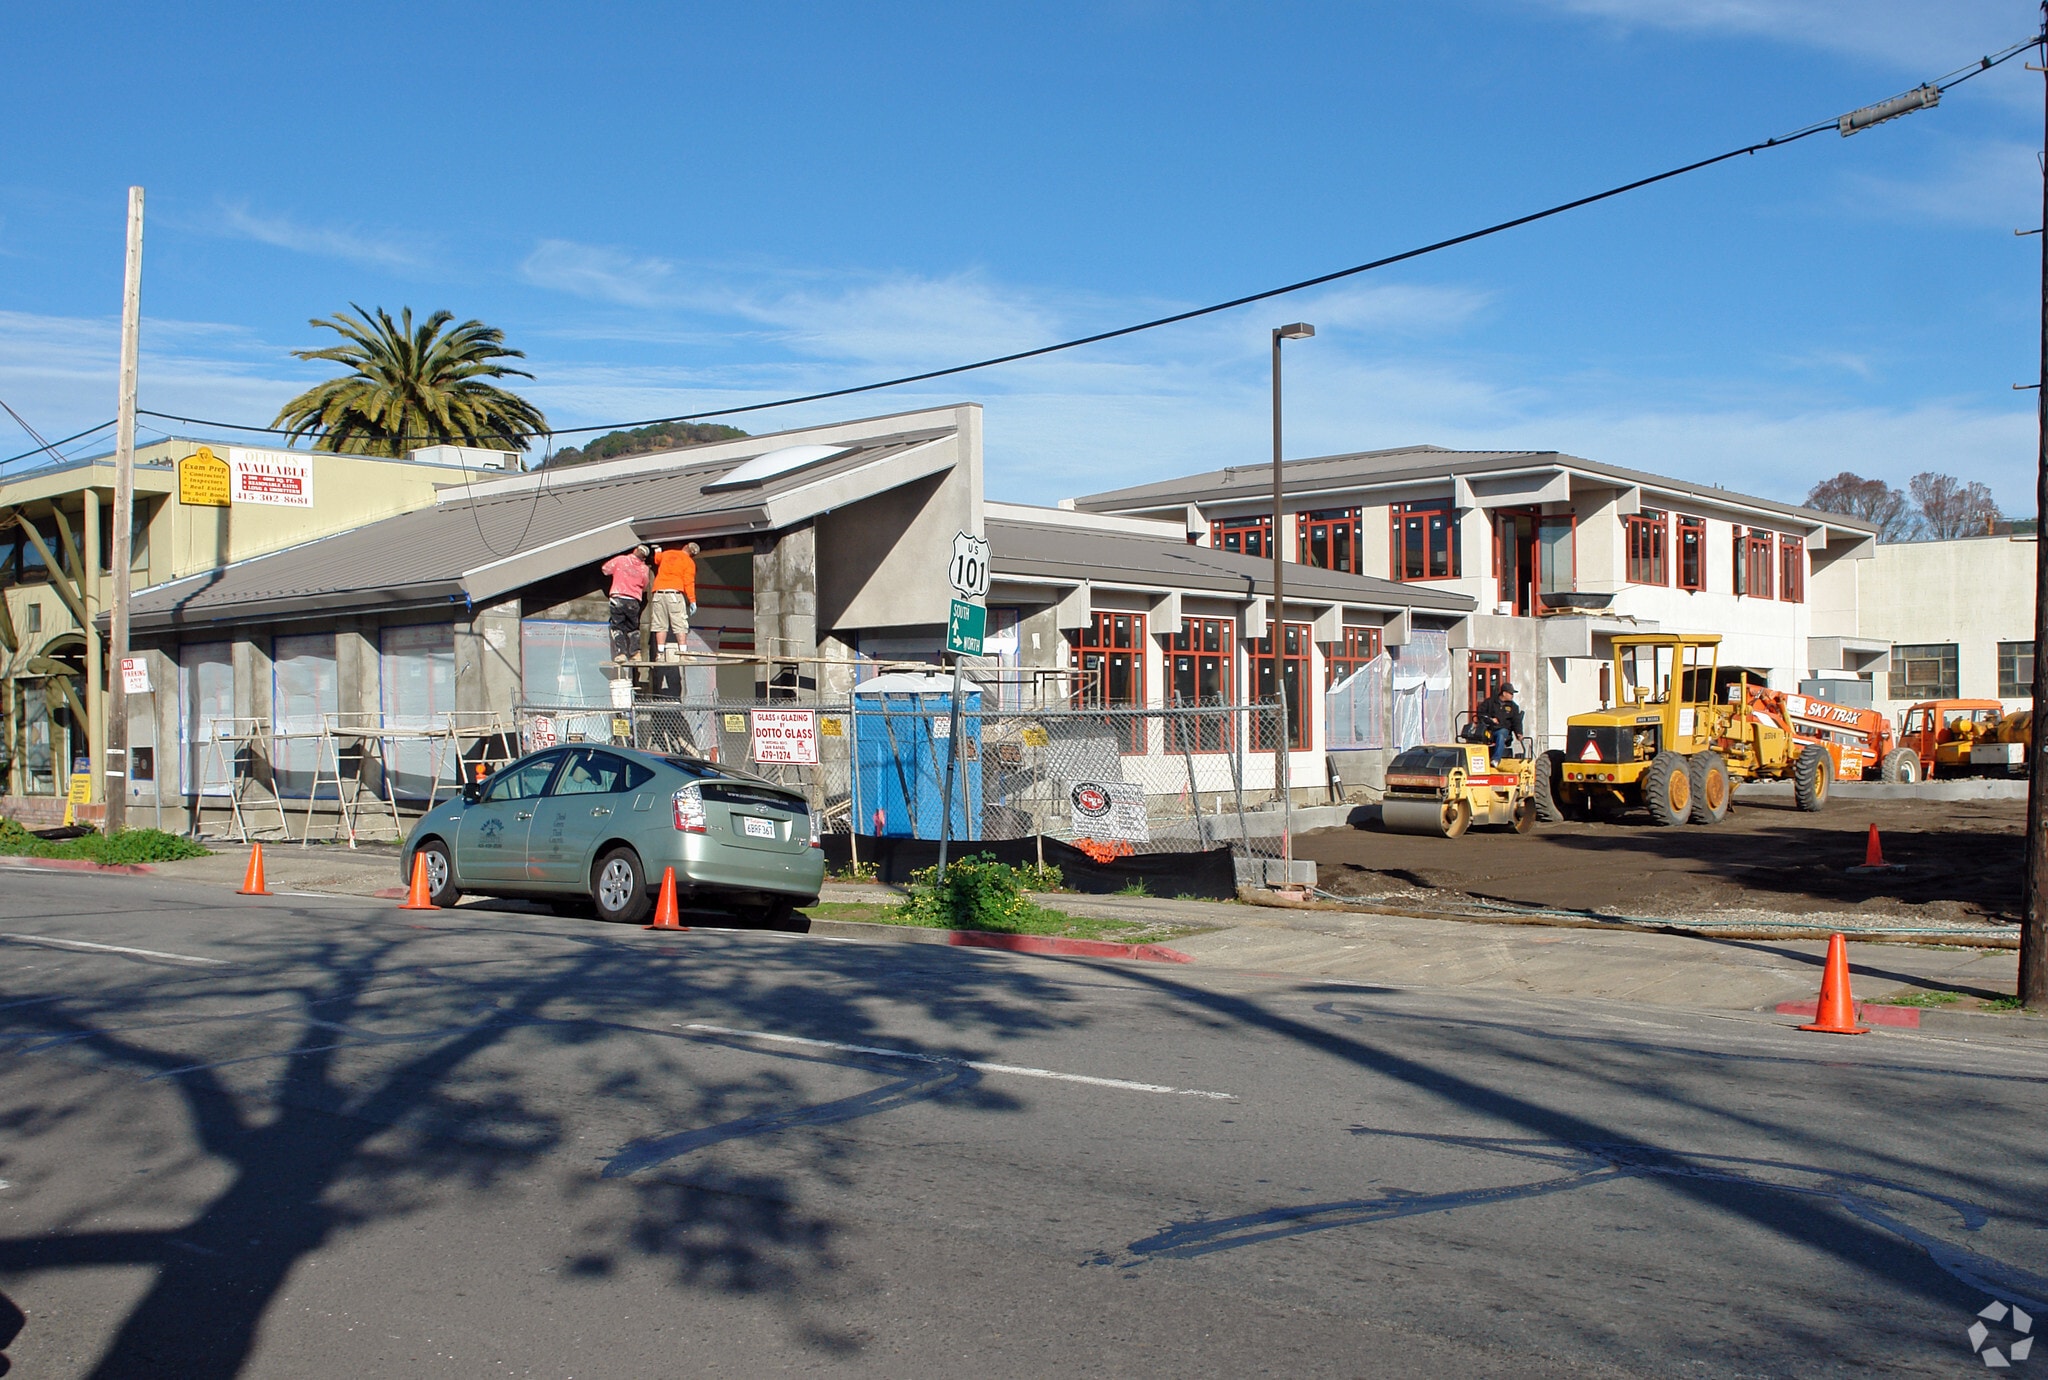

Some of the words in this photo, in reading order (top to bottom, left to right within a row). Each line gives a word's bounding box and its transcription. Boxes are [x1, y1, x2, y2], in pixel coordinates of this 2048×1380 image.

[246, 452, 298, 465] OFFICES
[184, 463, 206, 471] Exam
[208, 465, 227, 474] Prep
[236, 463, 308, 477] AVAILABLE
[236, 492, 308, 505] 415-302-8681
[968, 543, 979, 555] US
[956, 554, 986, 592] 101
[953, 604, 970, 620] SOUTH
[963, 636, 980, 652] NORTH
[123, 661, 132, 669] NO
[124, 669, 146, 678] PARKING
[757, 713, 776, 721] GLASS
[780, 713, 808, 722] GLAZING
[1808, 703, 1832, 719] SKY
[1833, 707, 1862, 725] TRAK
[755, 727, 782, 739] DOTTO
[784, 728, 813, 739] GLASS
[761, 750, 791, 760] 479-1274
